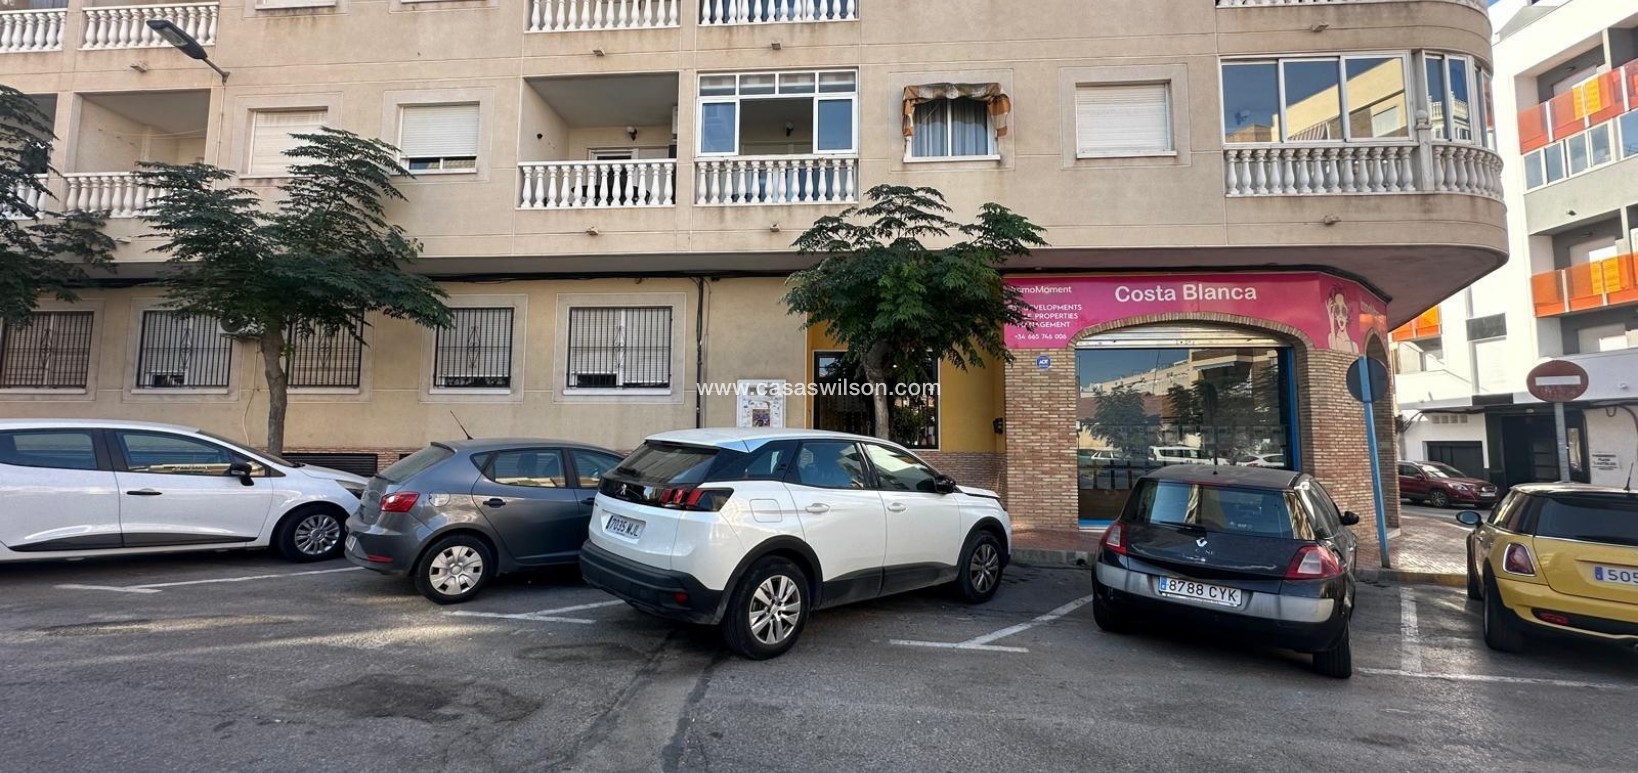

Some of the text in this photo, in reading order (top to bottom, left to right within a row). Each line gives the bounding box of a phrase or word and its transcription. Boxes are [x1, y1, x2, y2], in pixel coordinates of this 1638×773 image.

[1115, 284, 1257, 302] Costa Blanca
[610, 518, 627, 532] 7035
[1169, 580, 1204, 596] 8788
[1208, 586, 1237, 602] CYK
